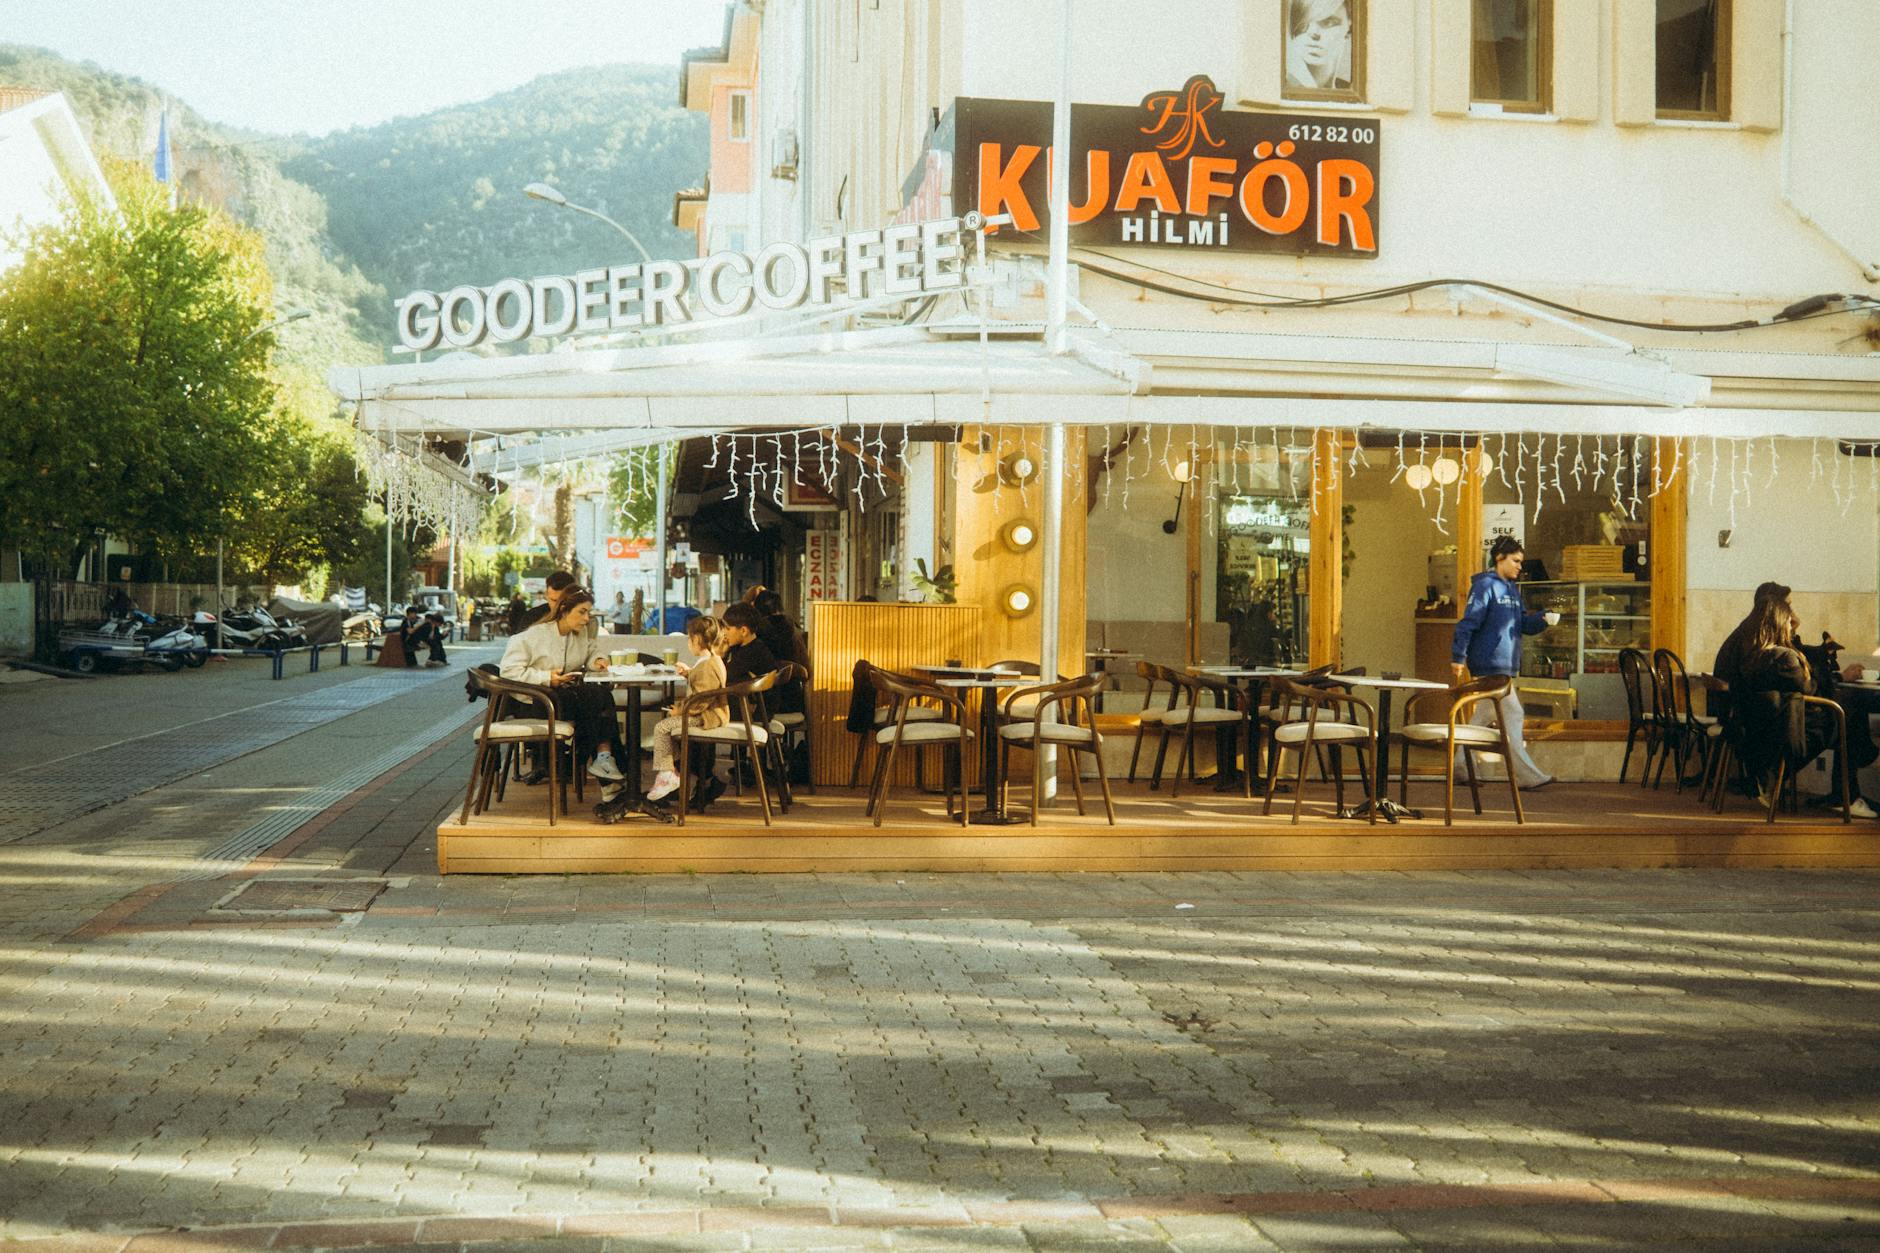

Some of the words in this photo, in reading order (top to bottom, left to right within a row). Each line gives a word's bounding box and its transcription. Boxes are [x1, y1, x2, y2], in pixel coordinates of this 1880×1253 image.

[1288, 124, 1322, 141] 612
[1326, 126, 1348, 143] 82
[1352, 127, 1374, 144] 00
[978, 141, 1376, 252] KUAFÖR
[397, 258, 692, 351] GOODEER
[698, 216, 964, 318] COFFEE
[1492, 527, 1515, 535] SELF
